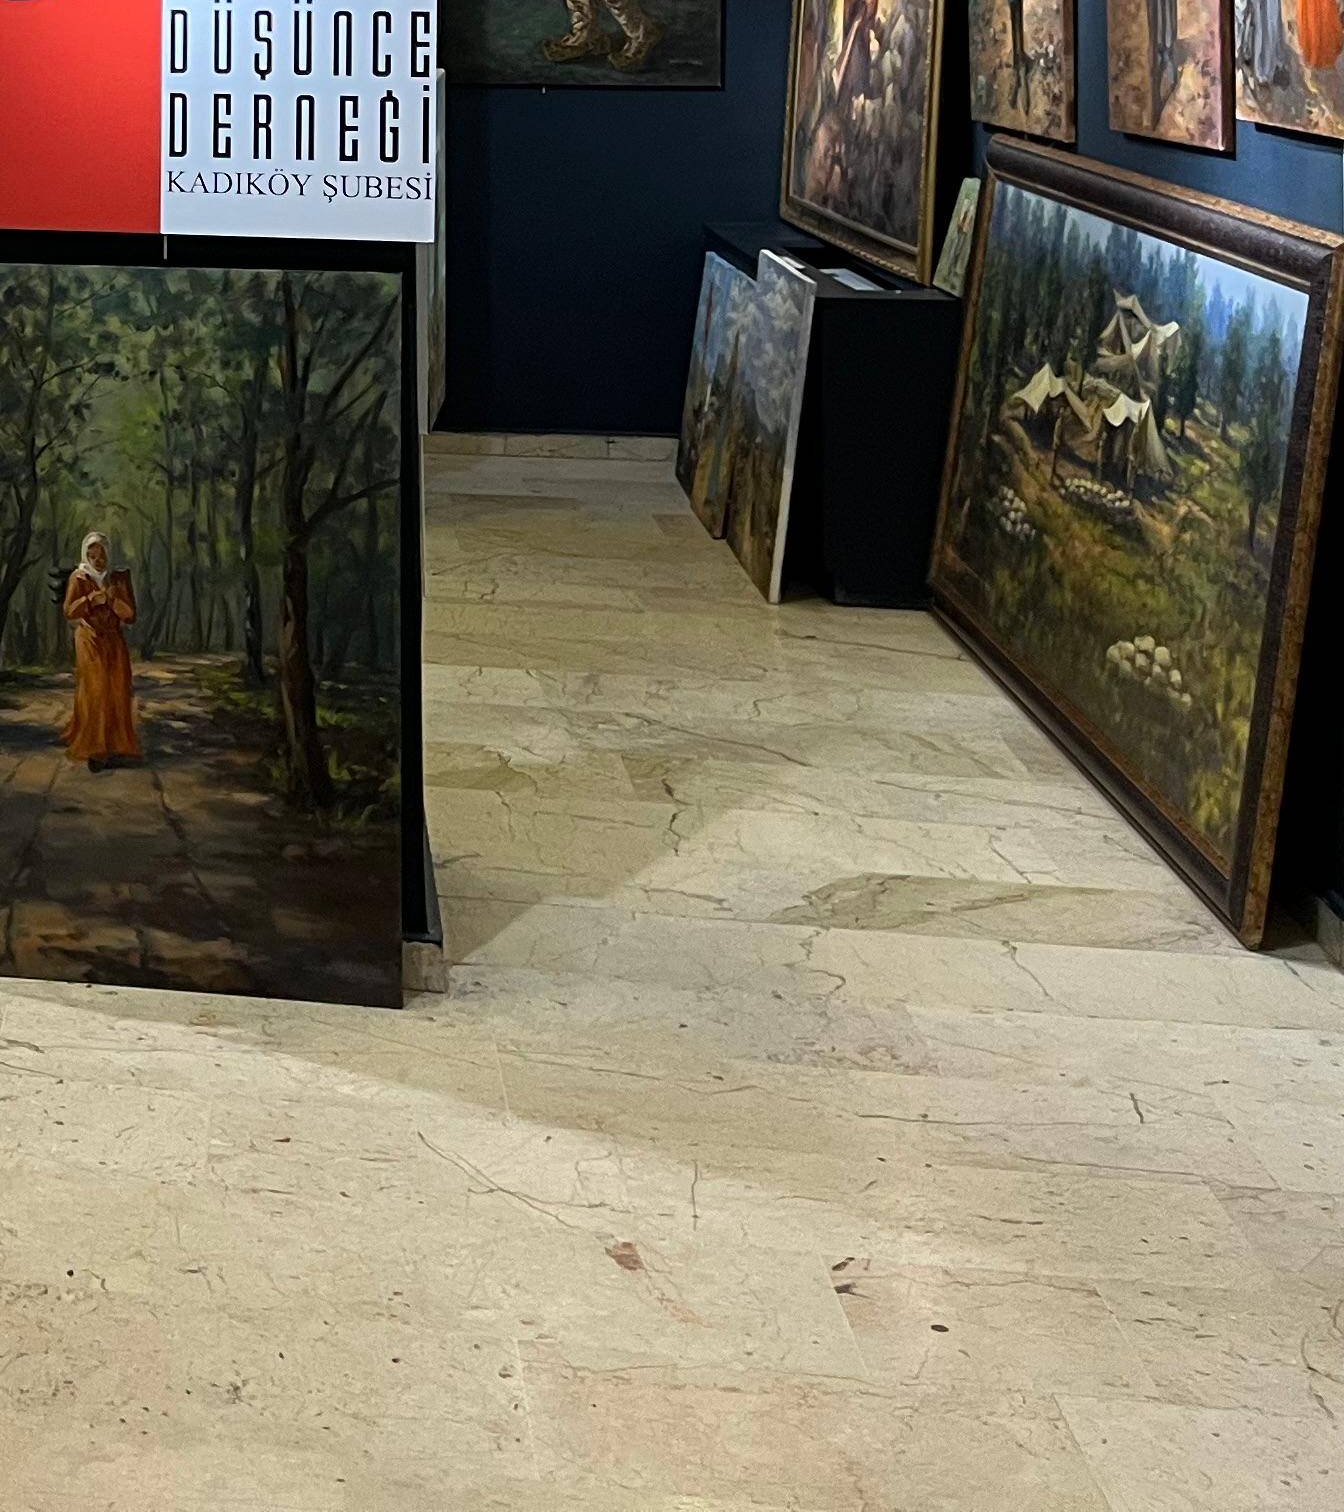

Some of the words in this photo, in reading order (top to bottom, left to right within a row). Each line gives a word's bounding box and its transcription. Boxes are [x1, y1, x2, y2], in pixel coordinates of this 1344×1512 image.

[168, 84, 430, 164] DERNEĞİ
[166, 168, 312, 196] KADIKÖY
[322, 172, 433, 203] ŞUBESİ
